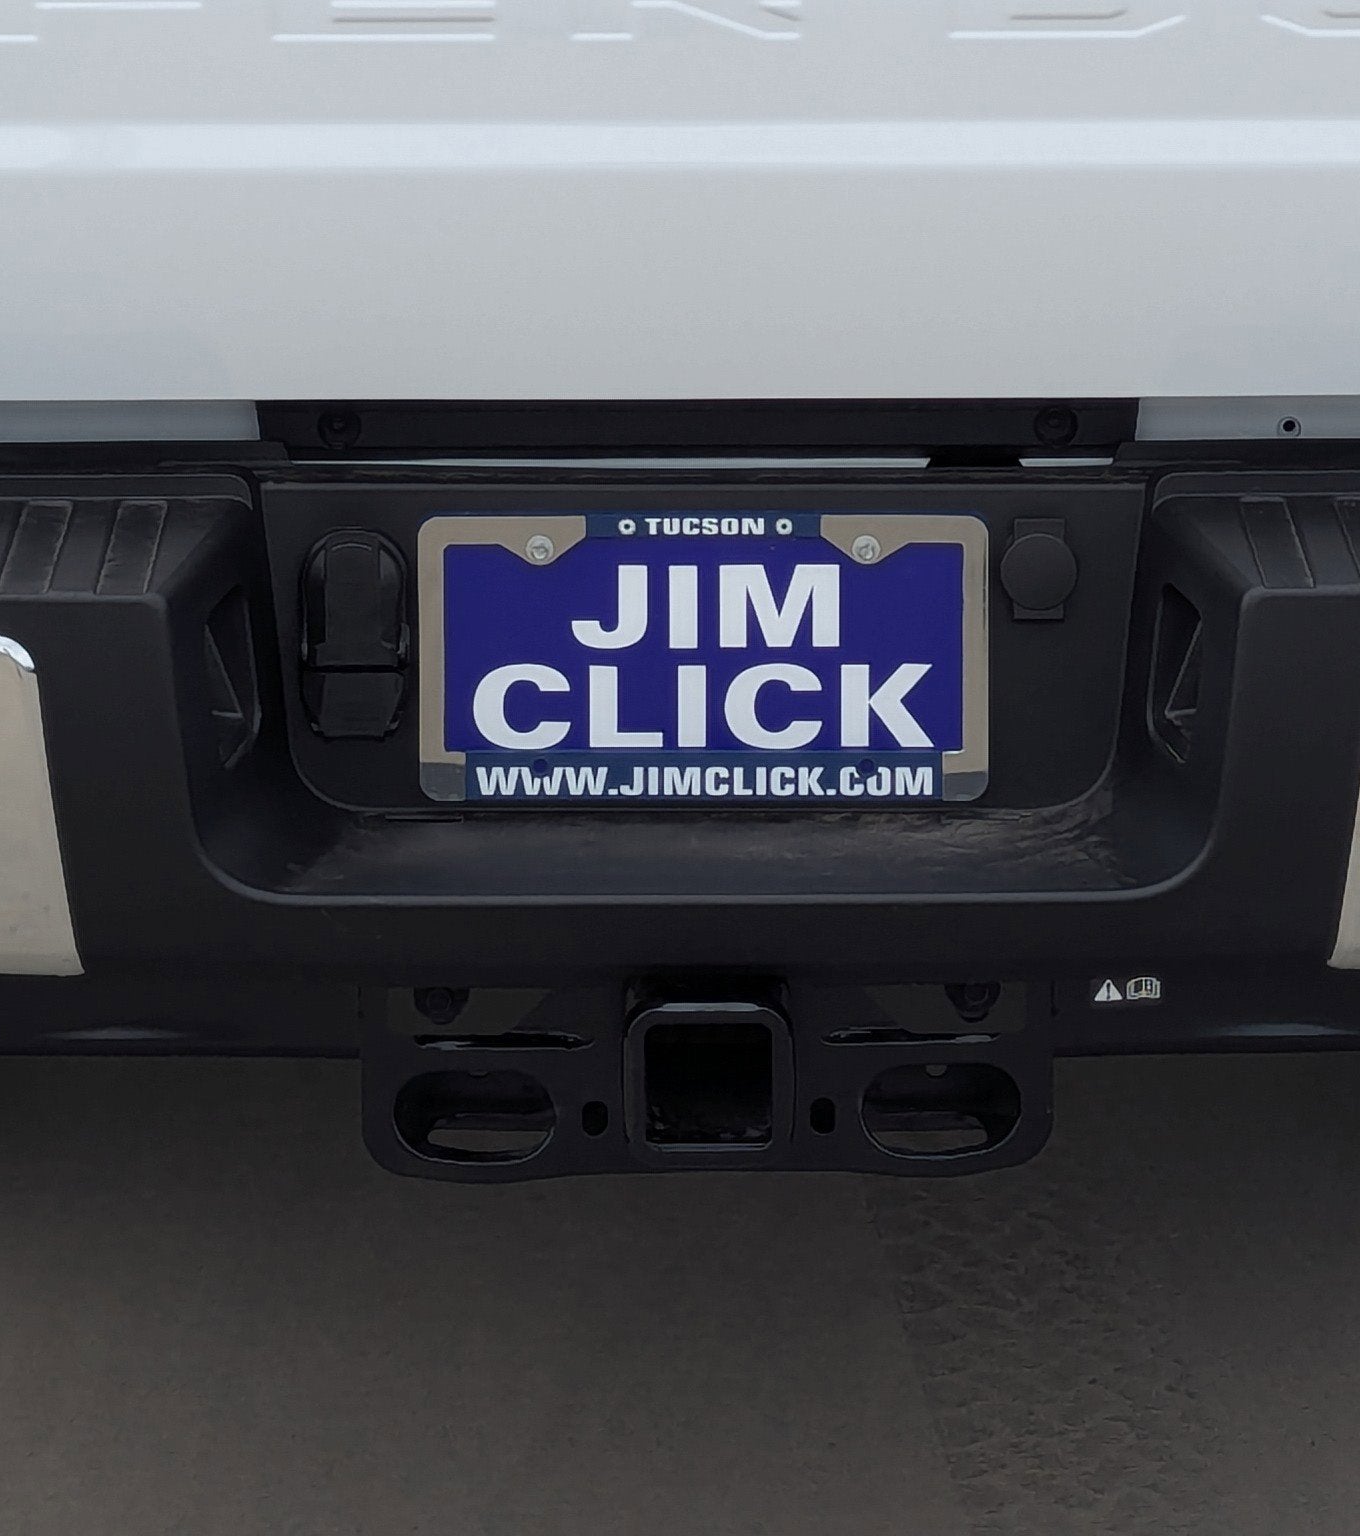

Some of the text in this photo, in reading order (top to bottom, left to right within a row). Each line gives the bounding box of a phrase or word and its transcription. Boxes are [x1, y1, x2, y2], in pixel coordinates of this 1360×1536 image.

[644, 516, 766, 536] TUCSON
[570, 564, 841, 649] JIM
[472, 662, 935, 750] CLICK
[475, 765, 934, 797] WWW.JIMCLICK.COM
